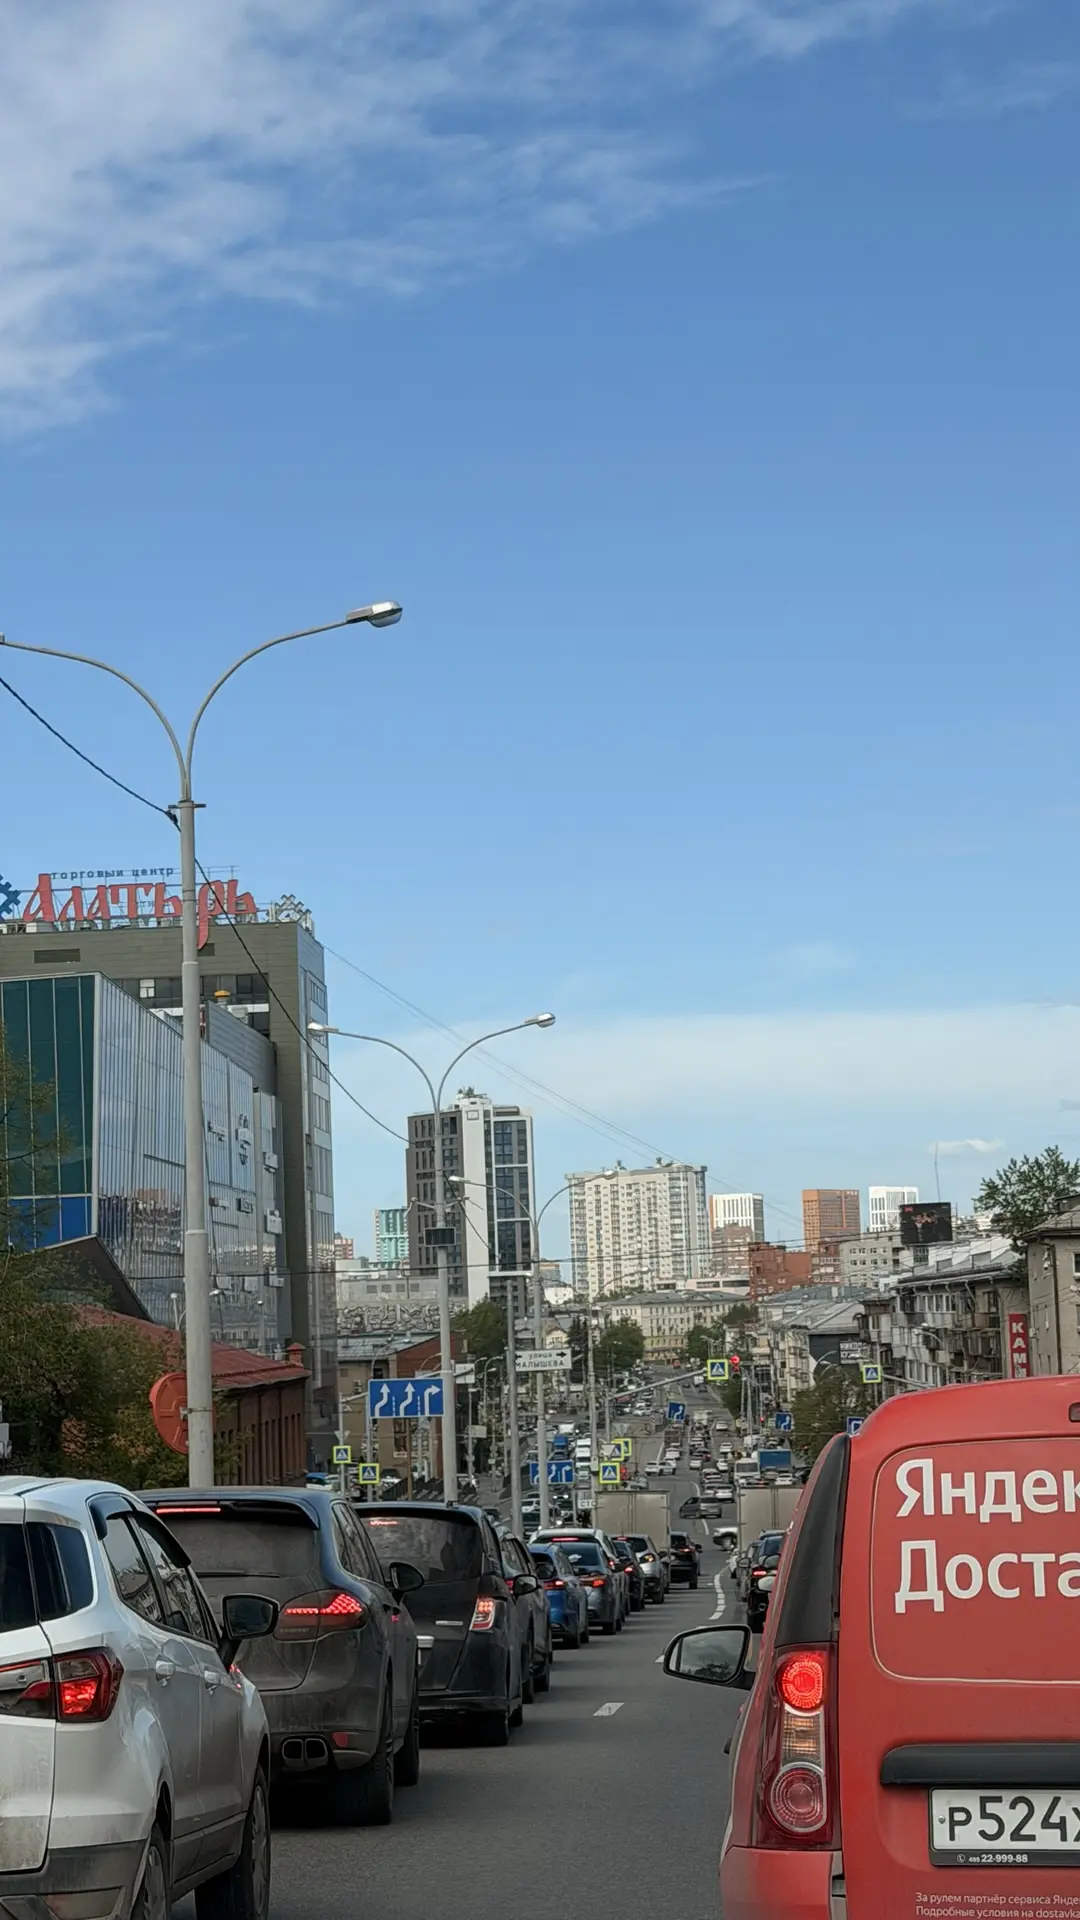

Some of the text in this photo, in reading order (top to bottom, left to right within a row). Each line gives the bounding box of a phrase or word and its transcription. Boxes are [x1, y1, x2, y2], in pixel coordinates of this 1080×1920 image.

[132, 867, 174, 879] центр
[895, 1539, 1080, 1614] Доста
[981, 1854, 1028, 1863] 22-999-88
[915, 1892, 928, 1902] За
[964, 1893, 1006, 1905] партнёр
[1008, 1895, 1051, 1906] сервиса
[916, 1906, 1080, 1918] Подробные условия на dostavka
